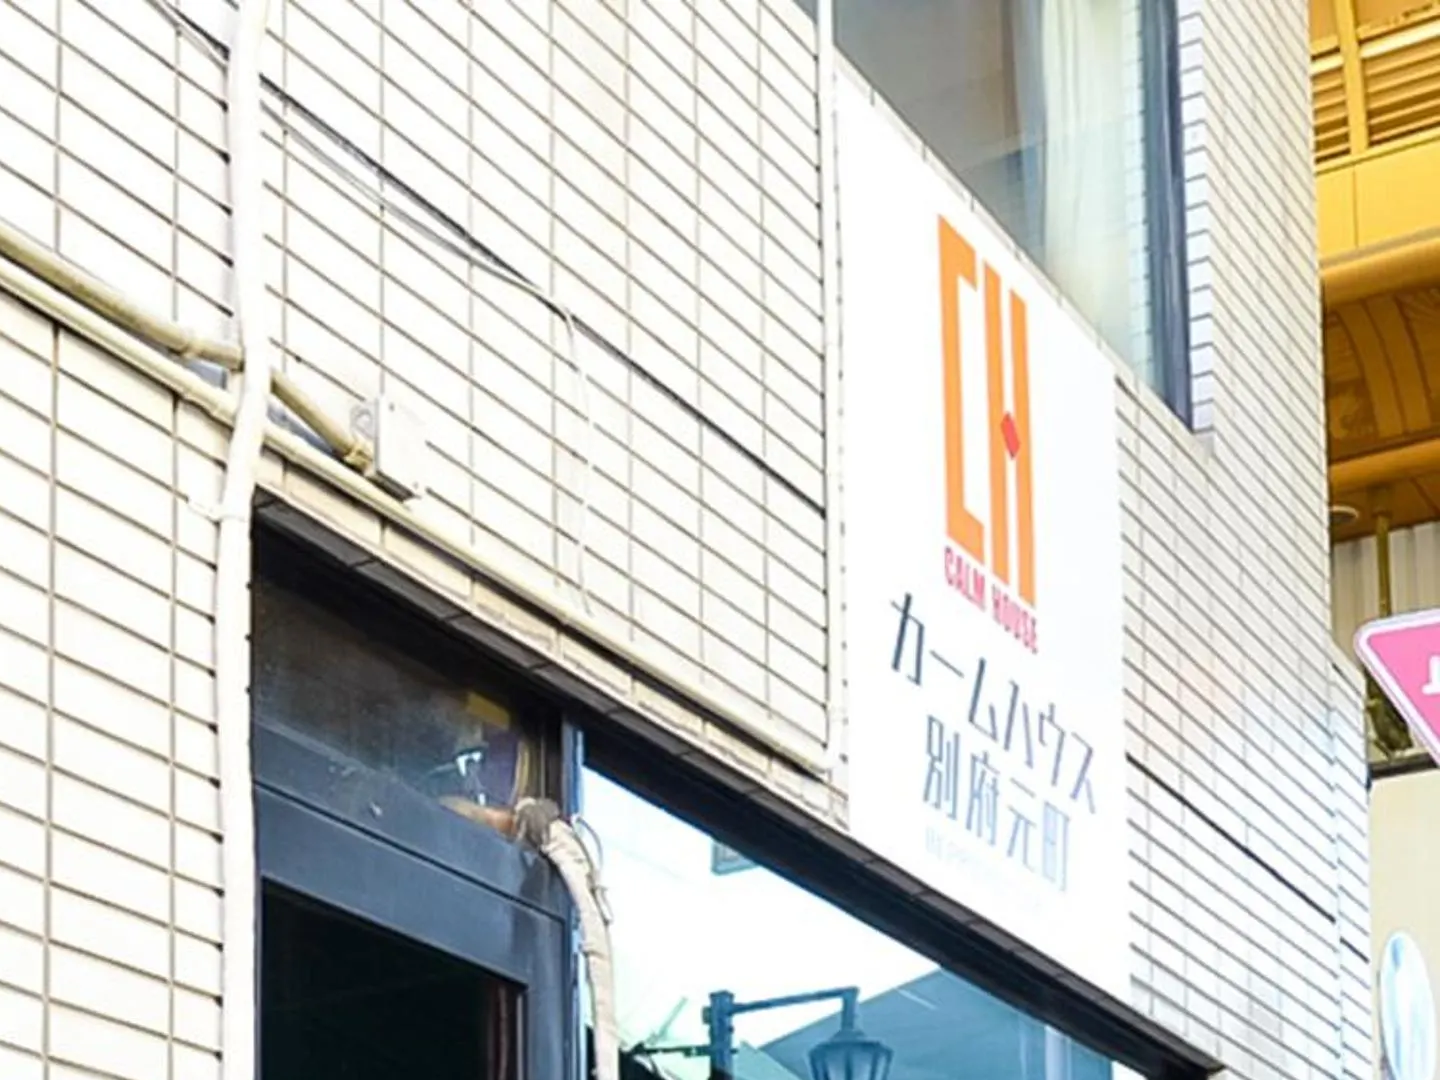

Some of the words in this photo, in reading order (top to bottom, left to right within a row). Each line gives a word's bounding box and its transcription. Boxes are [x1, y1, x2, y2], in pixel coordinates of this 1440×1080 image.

[944, 546, 986, 612] CALM
[992, 583, 1038, 654] HOUSE
[890, 593, 1096, 814] カームハウス
[922, 714, 1071, 892] 別府元町
